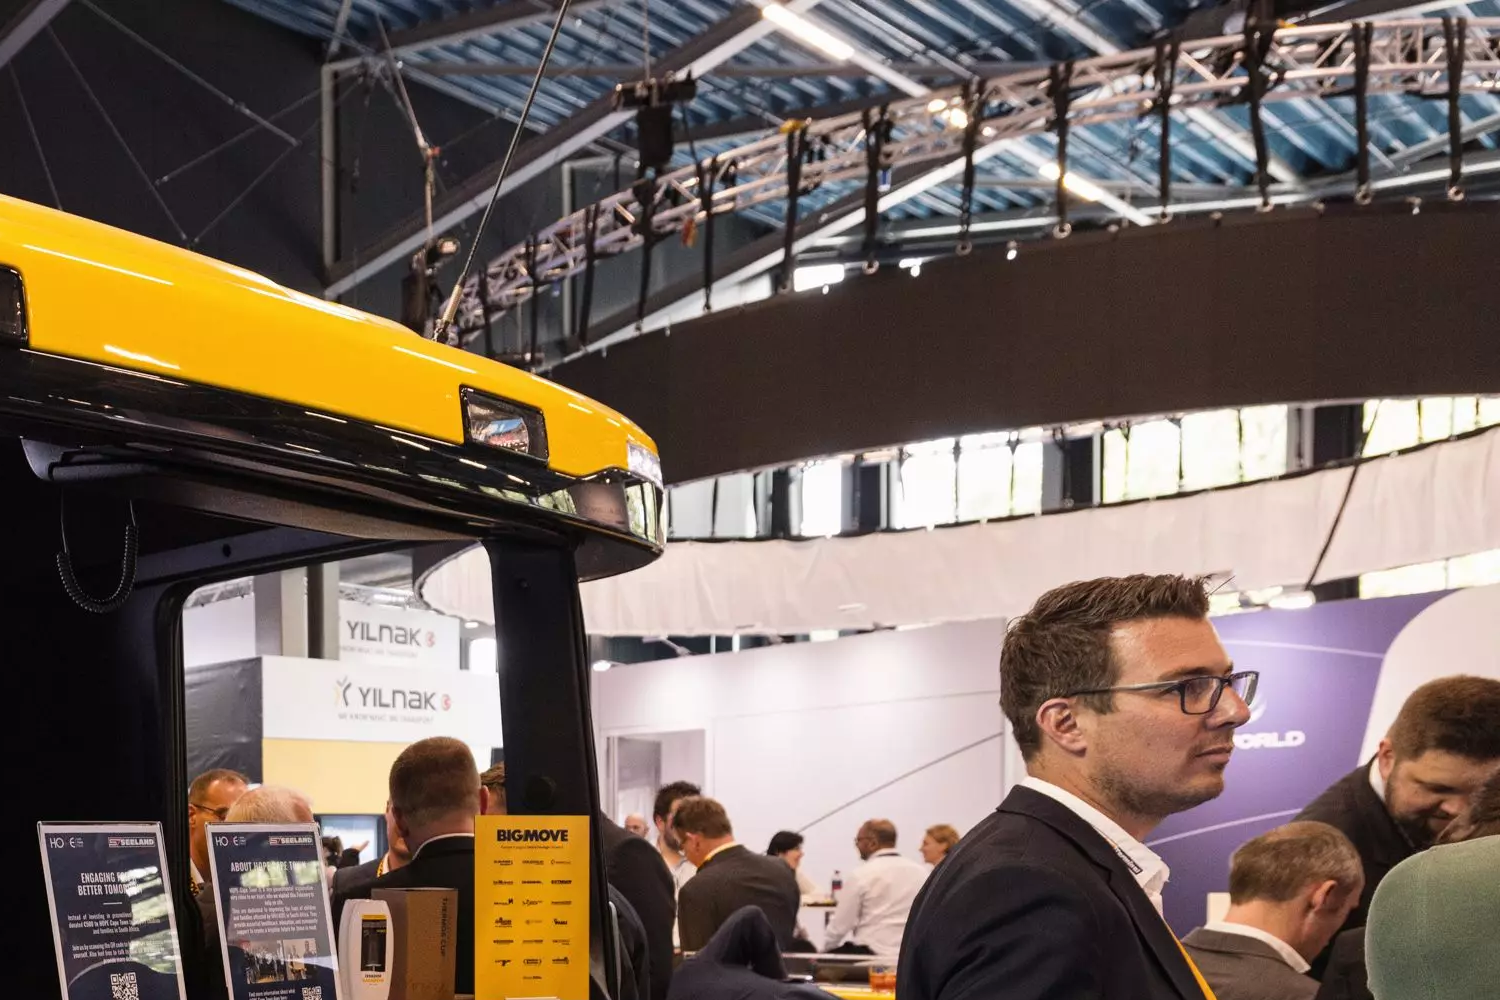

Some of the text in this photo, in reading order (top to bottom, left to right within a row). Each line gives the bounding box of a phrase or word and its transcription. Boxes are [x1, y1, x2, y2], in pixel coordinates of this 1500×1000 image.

[497, 829, 568, 842] BIGMOVE
[121, 838, 154, 846] SEELAND
[230, 862, 252, 872] ABOUT
[80, 872, 115, 884] ENGAGING
[77, 883, 142, 896] BETTER TOMOR
